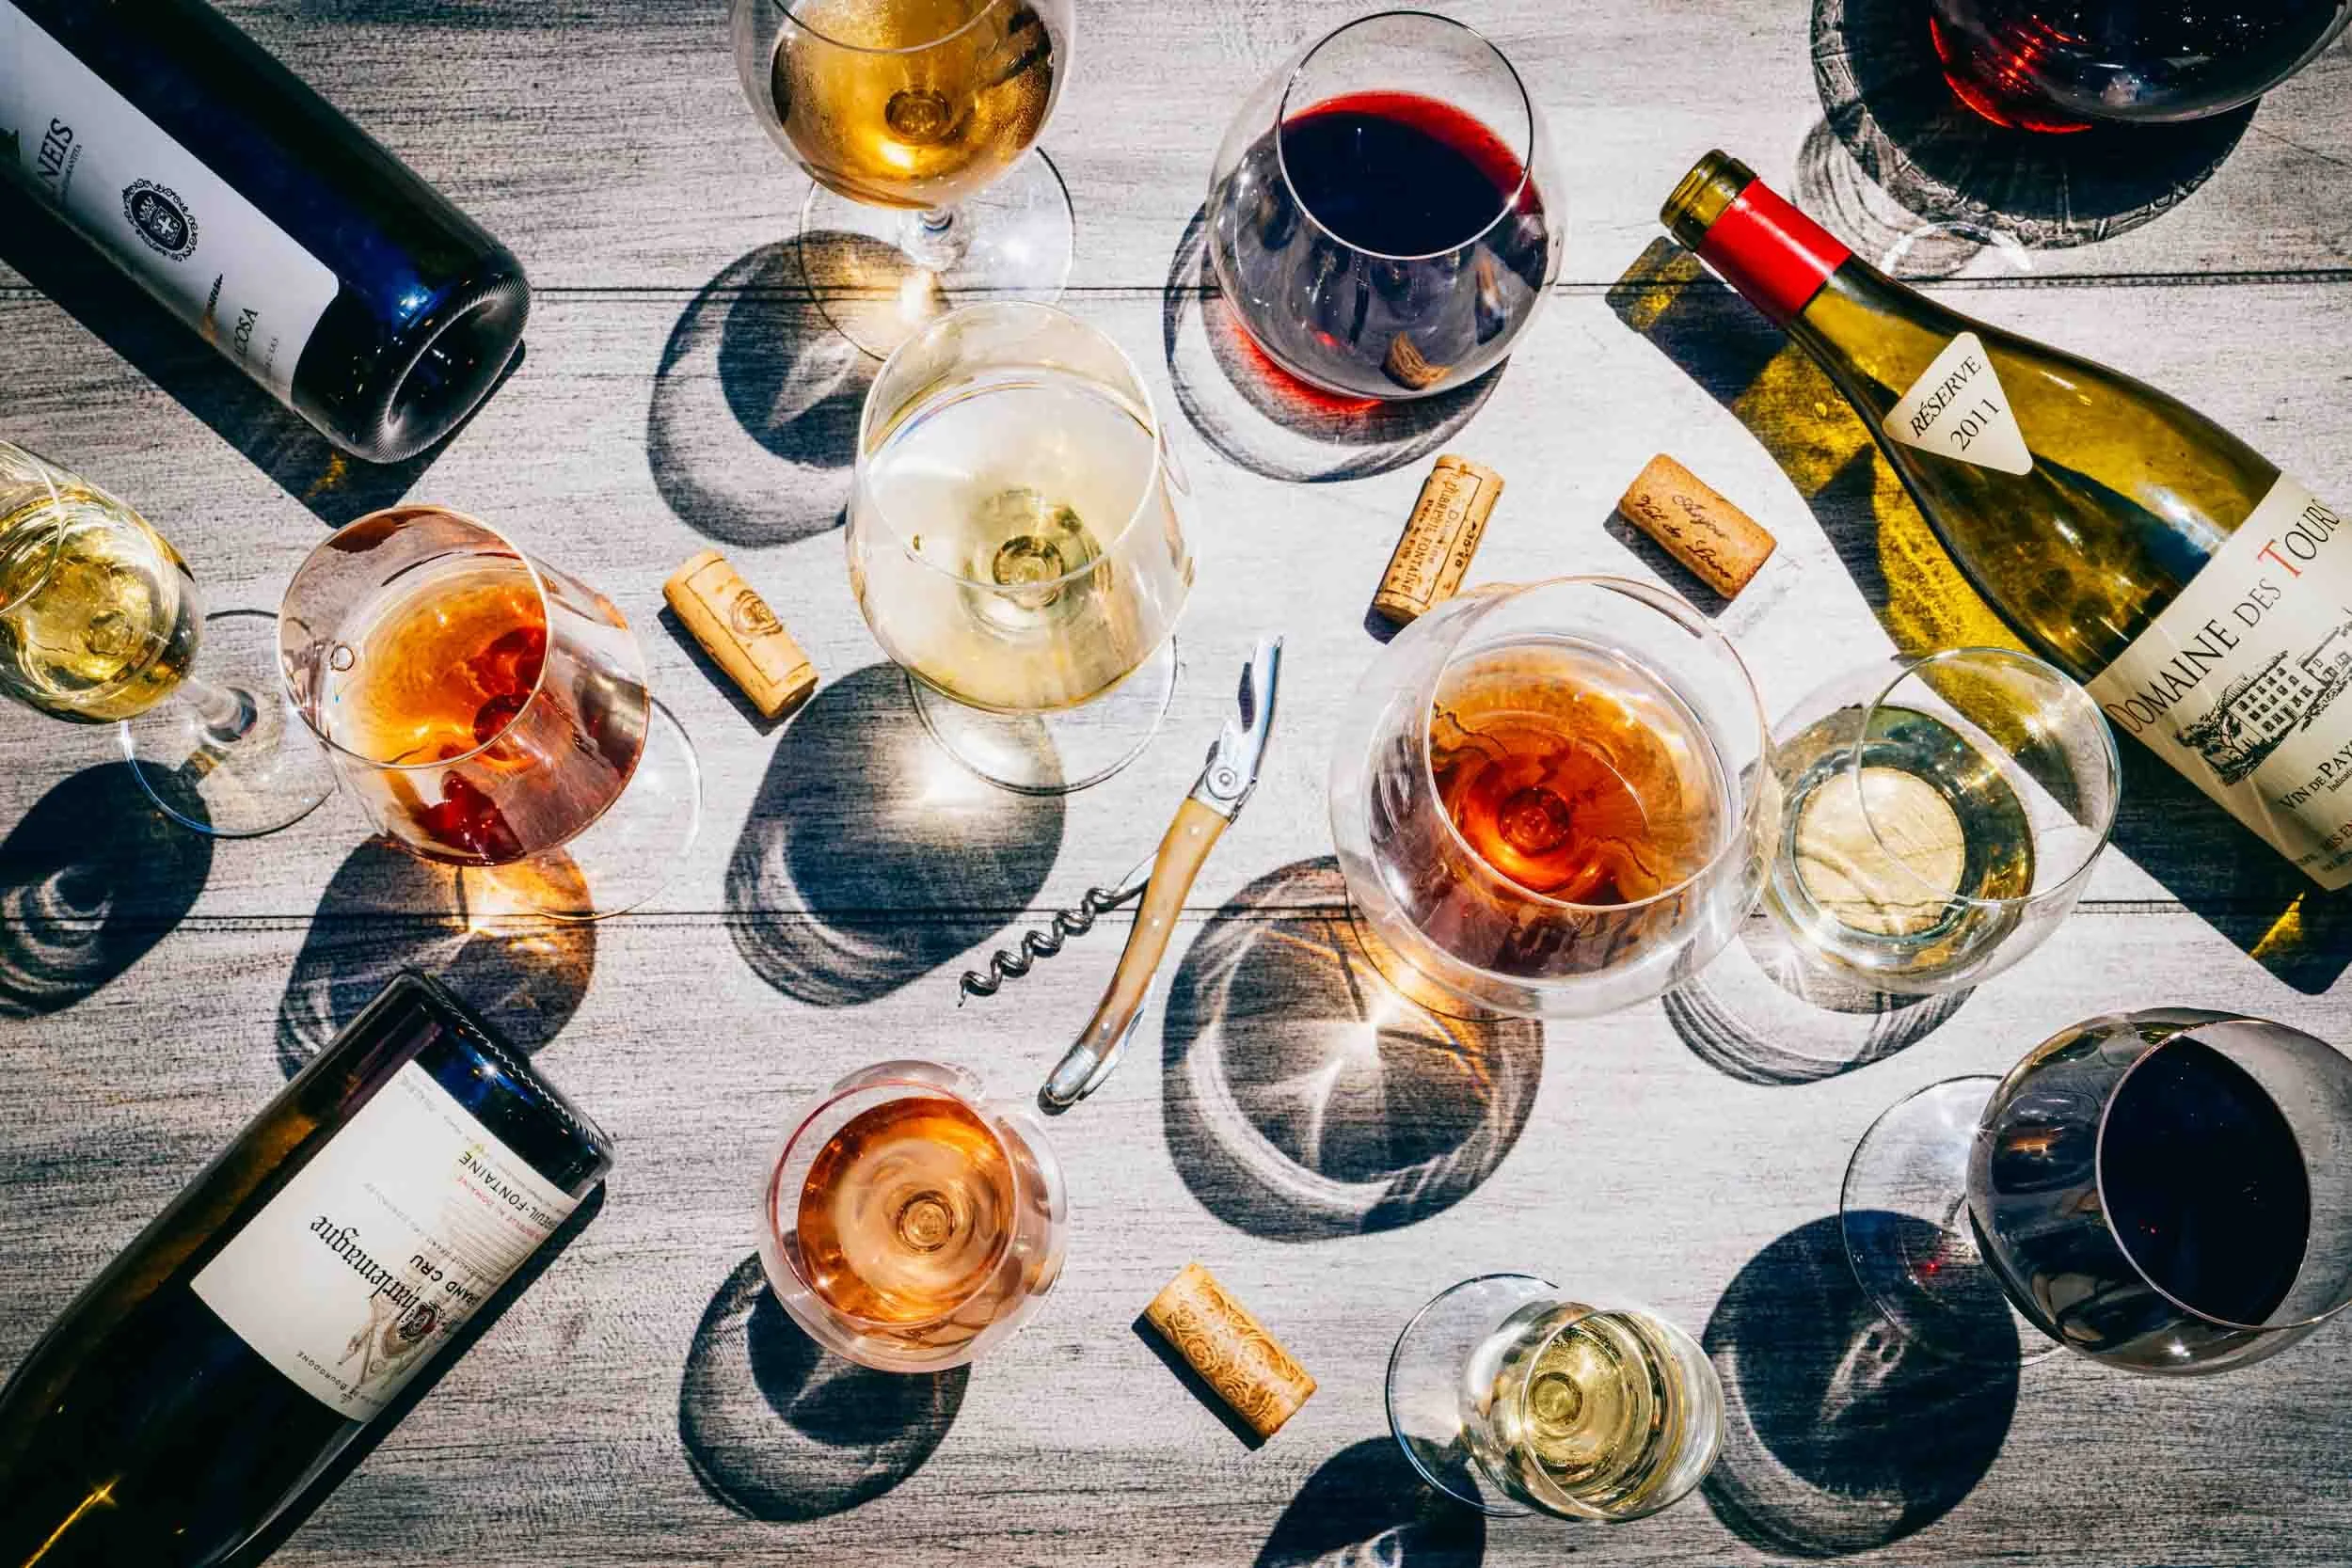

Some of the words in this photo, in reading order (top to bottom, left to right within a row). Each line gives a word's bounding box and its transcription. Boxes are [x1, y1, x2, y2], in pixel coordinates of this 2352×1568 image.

[38, 119, 73, 181] NEIS
[1910, 356, 1982, 438] RÉSERVE
[1949, 399, 2001, 451] 2011
[2106, 618, 2241, 734] DOMAINE
[2233, 578, 2281, 627] DES
[2257, 498, 2341, 579] TOURS
[2280, 786, 2312, 810] VIN
[2309, 775, 2327, 791] DE
[2318, 739, 2352, 779] PAY
[2328, 767, 2352, 792] Indicati
[409, 1254, 443, 1283] CRU
